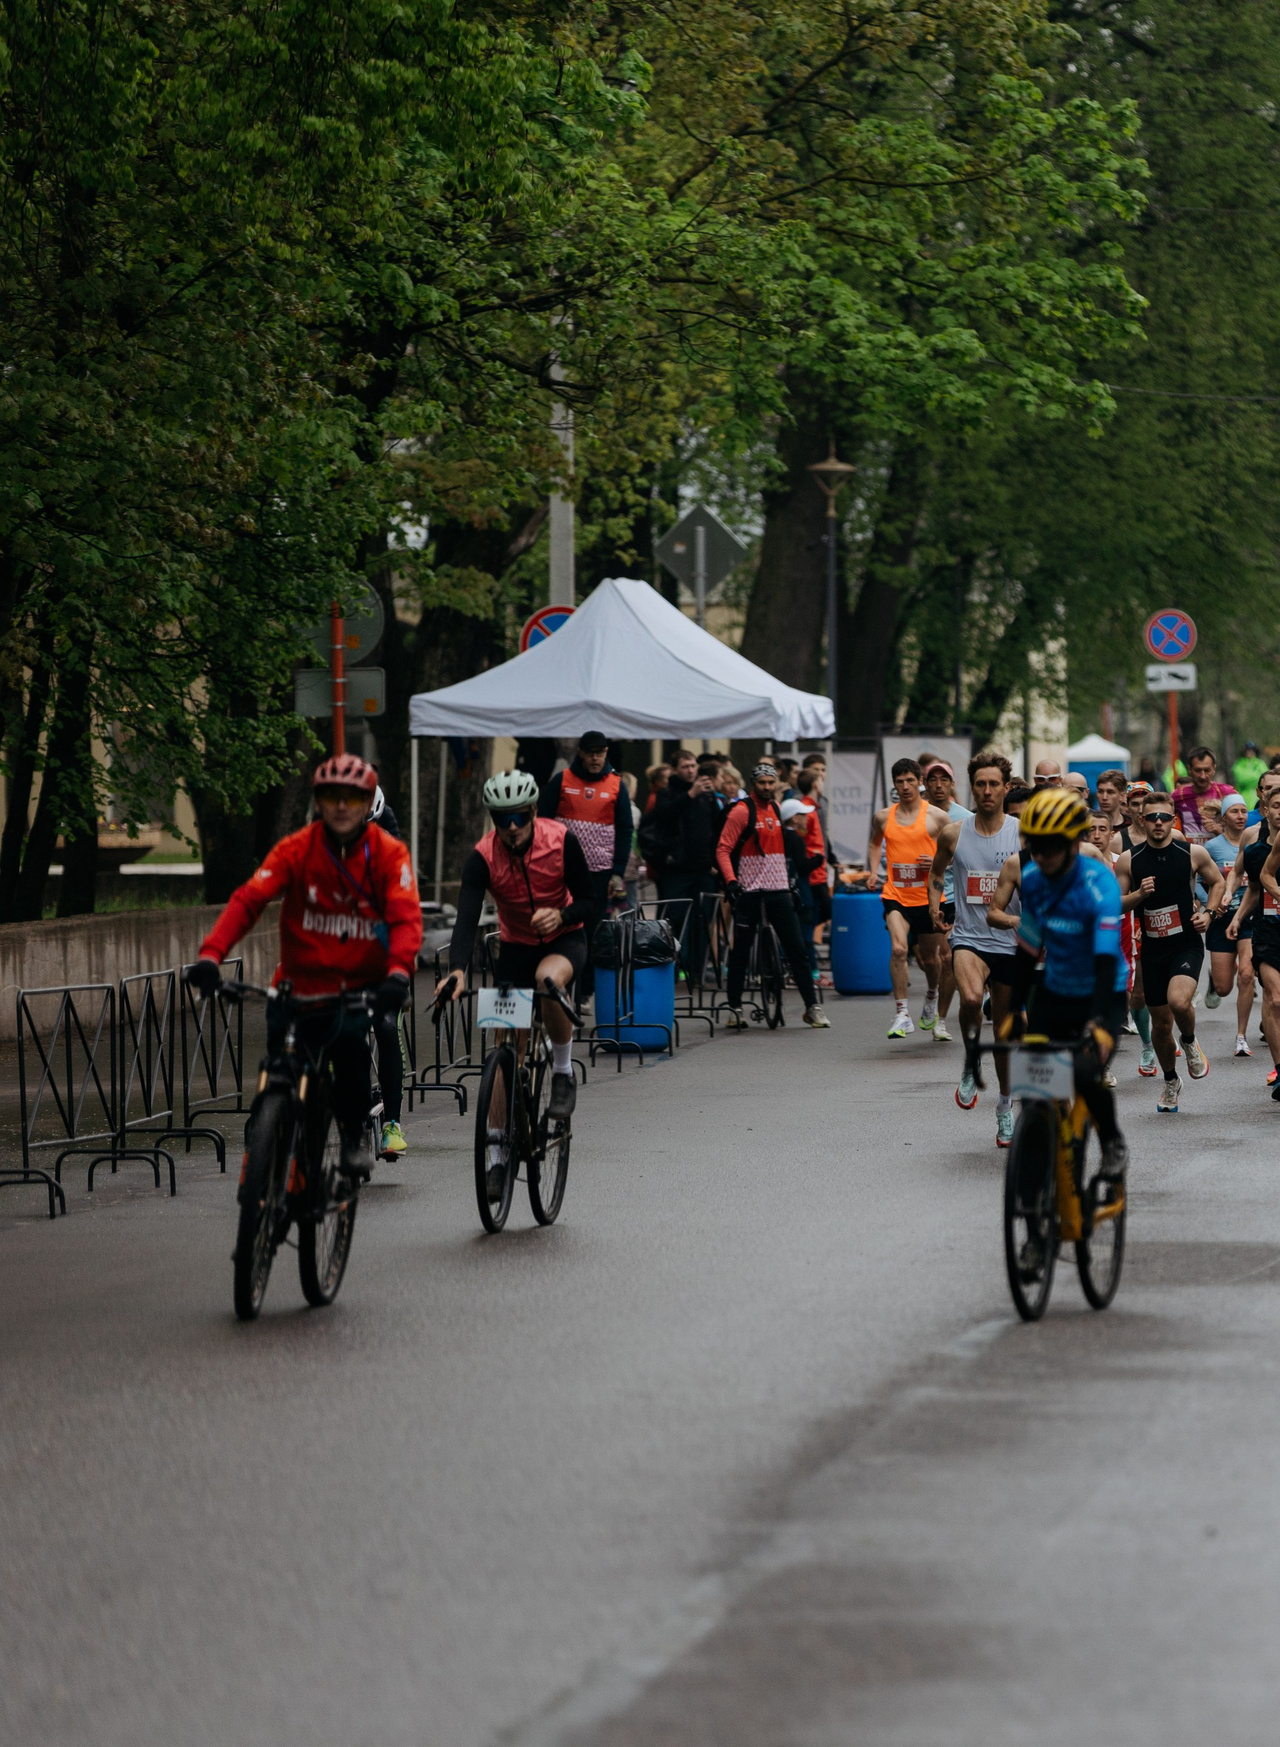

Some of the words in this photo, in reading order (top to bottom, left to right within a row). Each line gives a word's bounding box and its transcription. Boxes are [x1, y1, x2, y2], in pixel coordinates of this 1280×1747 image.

[899, 868, 917, 880] 1049
[979, 878, 998, 892] 636
[1149, 913, 1172, 928] 2026
